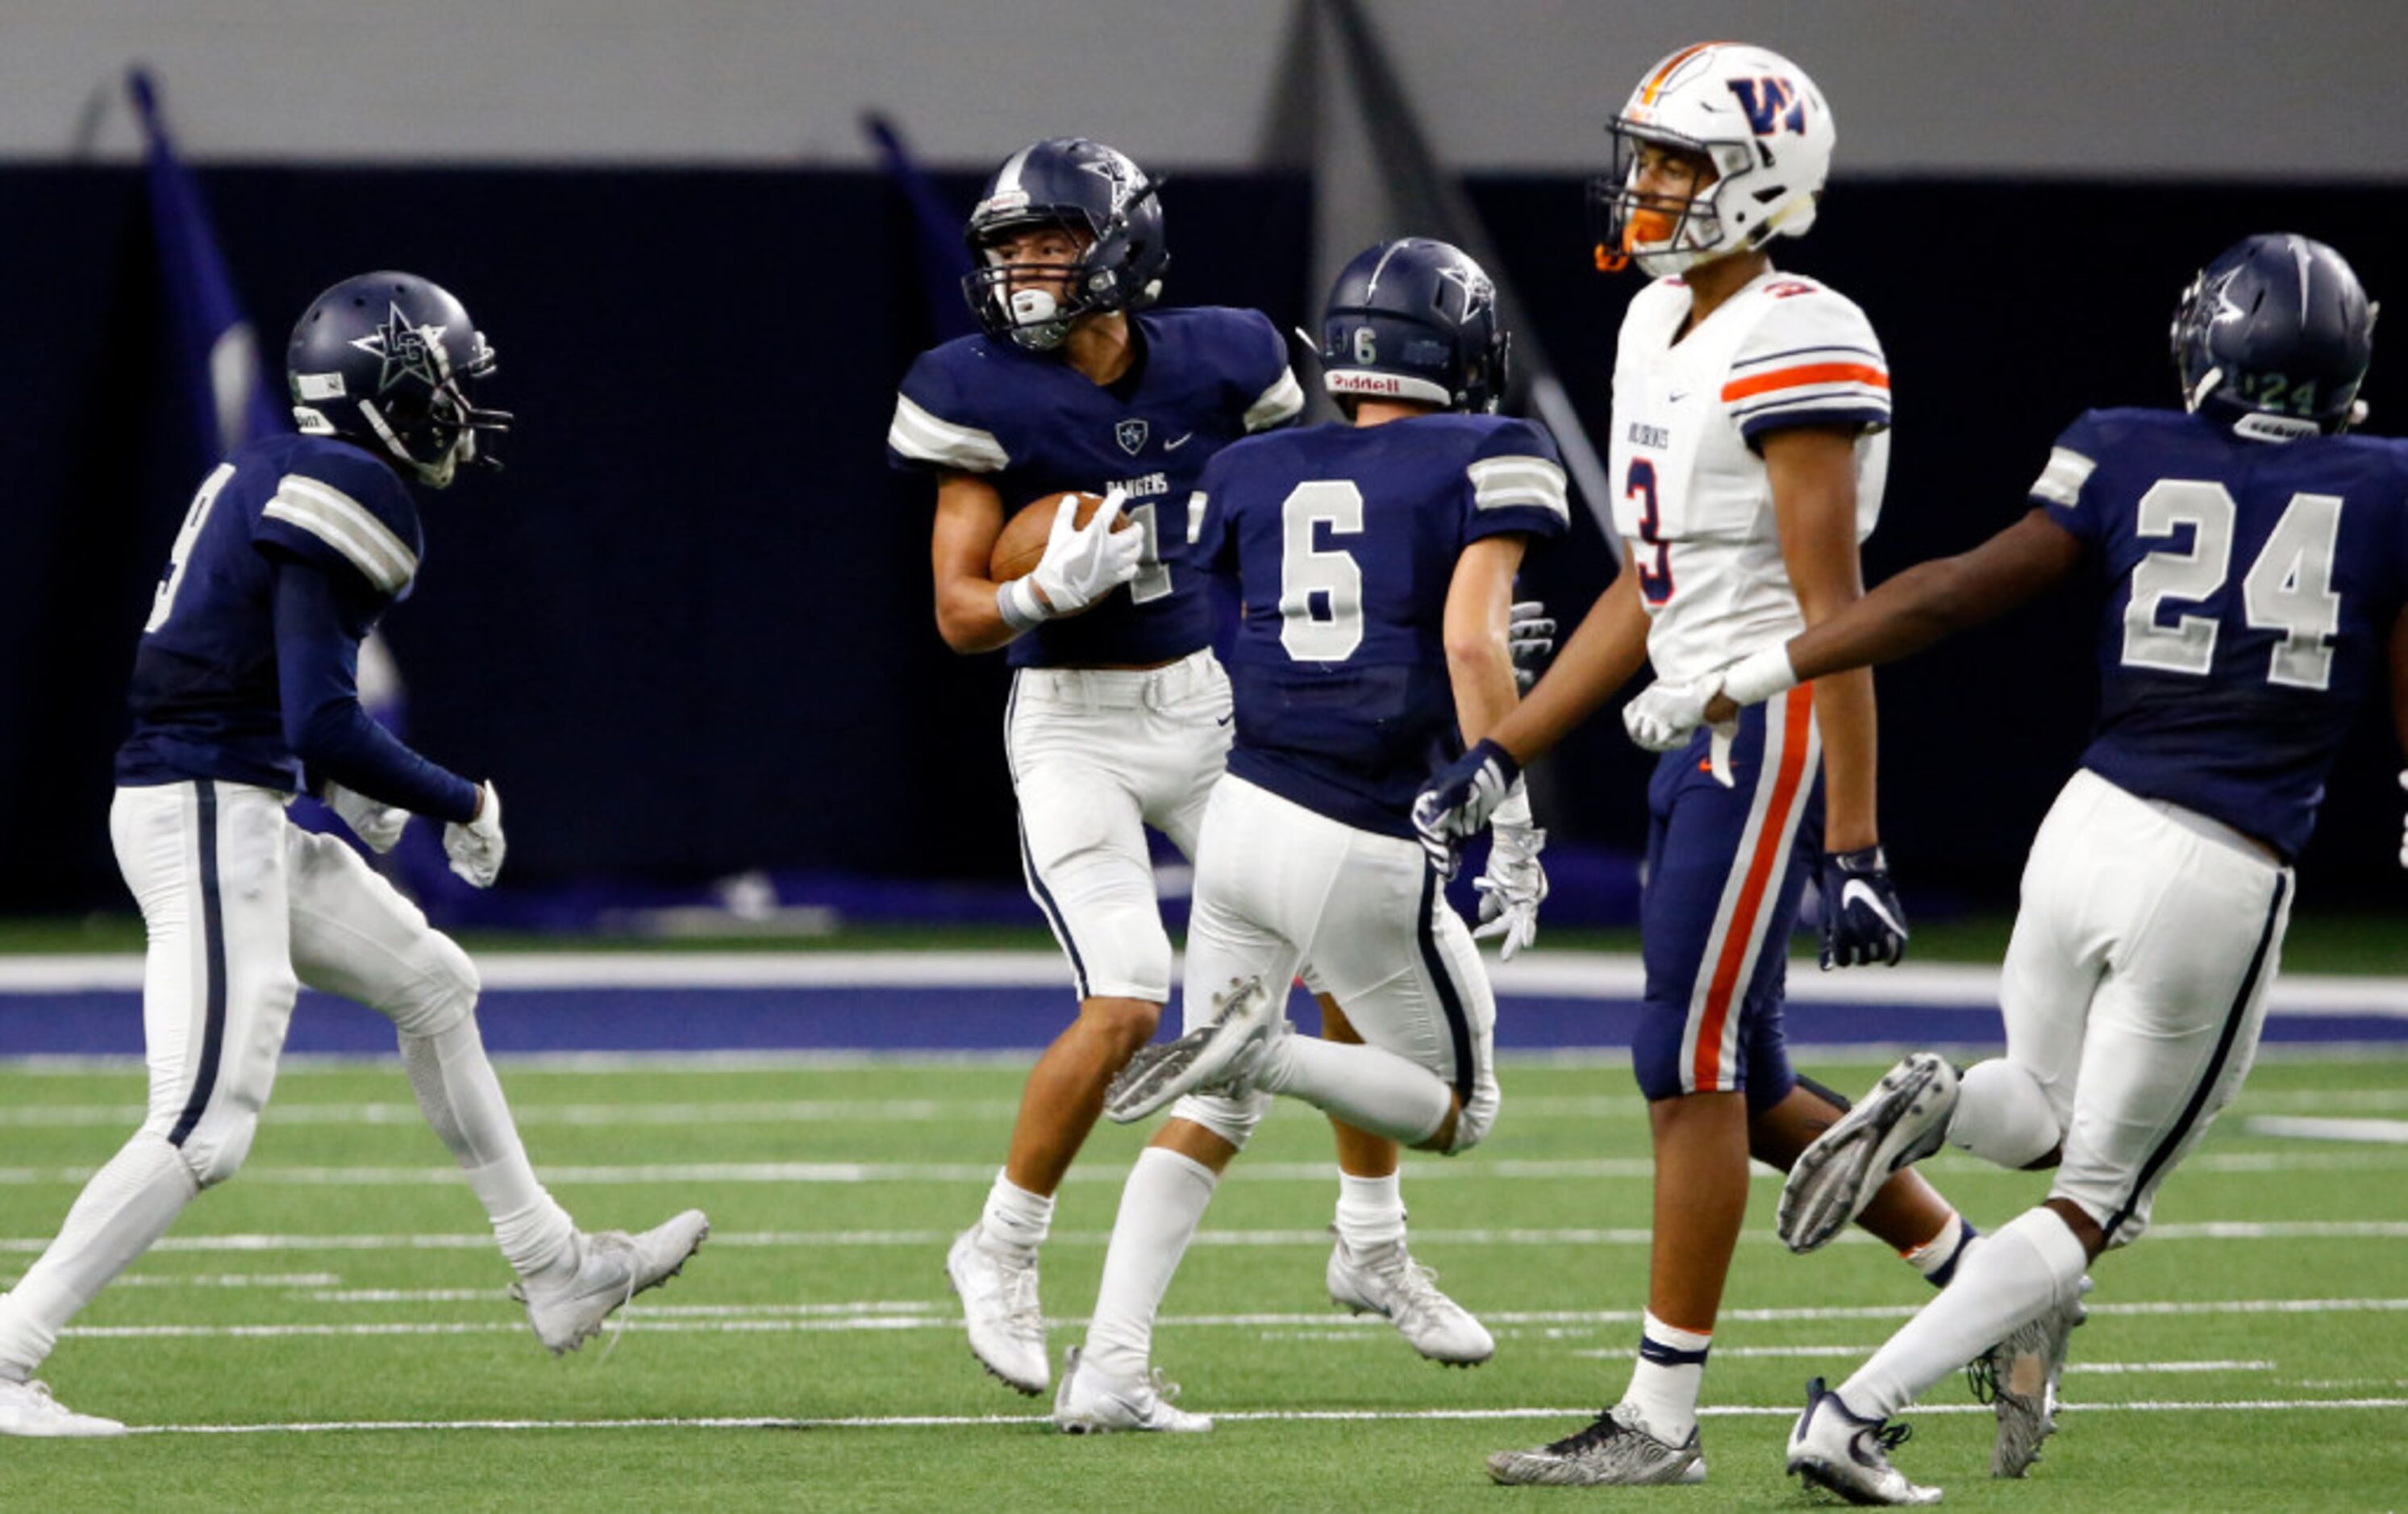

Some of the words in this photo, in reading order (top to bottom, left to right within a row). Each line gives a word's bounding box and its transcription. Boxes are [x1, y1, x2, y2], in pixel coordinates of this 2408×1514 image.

[1725, 77, 1806, 136] W
[1355, 327, 1377, 364] 6
[1333, 373, 1401, 393] Riddell
[2260, 372, 2318, 416] 24
[1625, 455, 1675, 607] 3
[1279, 480, 1364, 662] 6
[2120, 479, 2344, 691] 24
